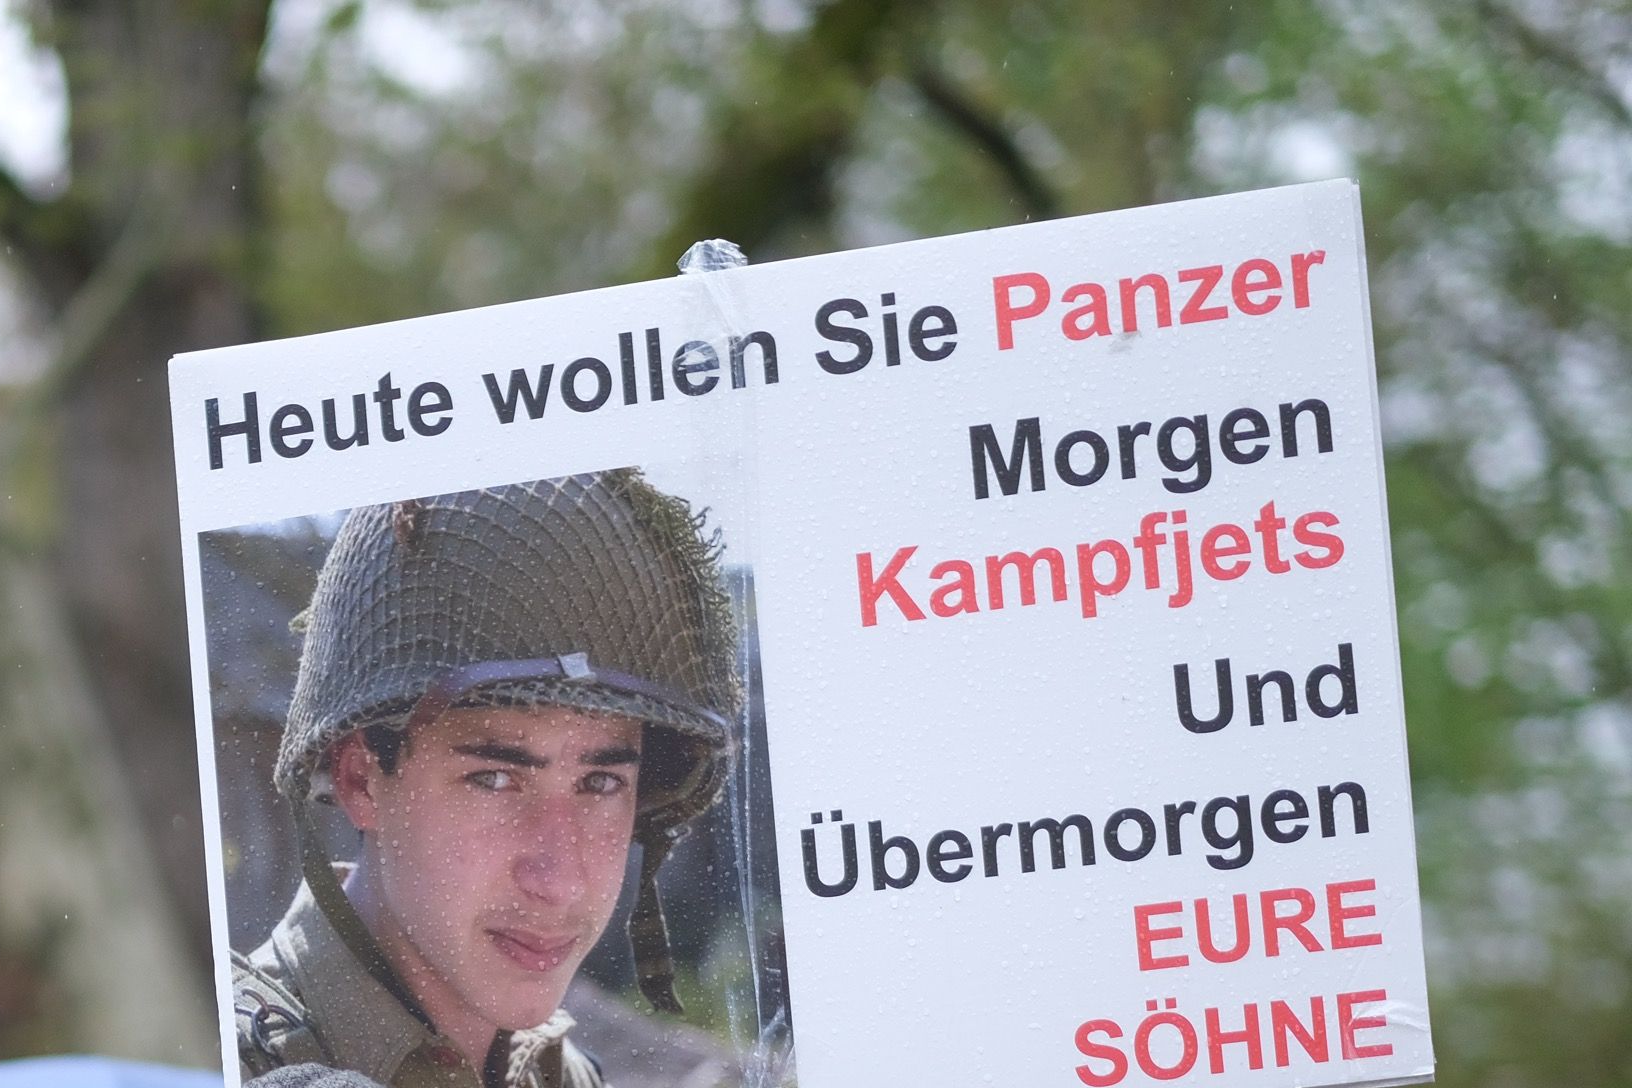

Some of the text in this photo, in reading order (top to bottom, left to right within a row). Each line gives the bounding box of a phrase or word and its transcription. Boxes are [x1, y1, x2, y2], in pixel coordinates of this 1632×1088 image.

[205, 249, 1326, 470] Heute wollen Sie Panzer
[968, 396, 1334, 500] Morgen
[856, 500, 1344, 627] Kampfjets
[1173, 643, 1359, 733] Und
[801, 781, 1369, 897] Übermorgen
[1133, 878, 1382, 970] EURE
[1074, 989, 1393, 1087] SÖHNE
